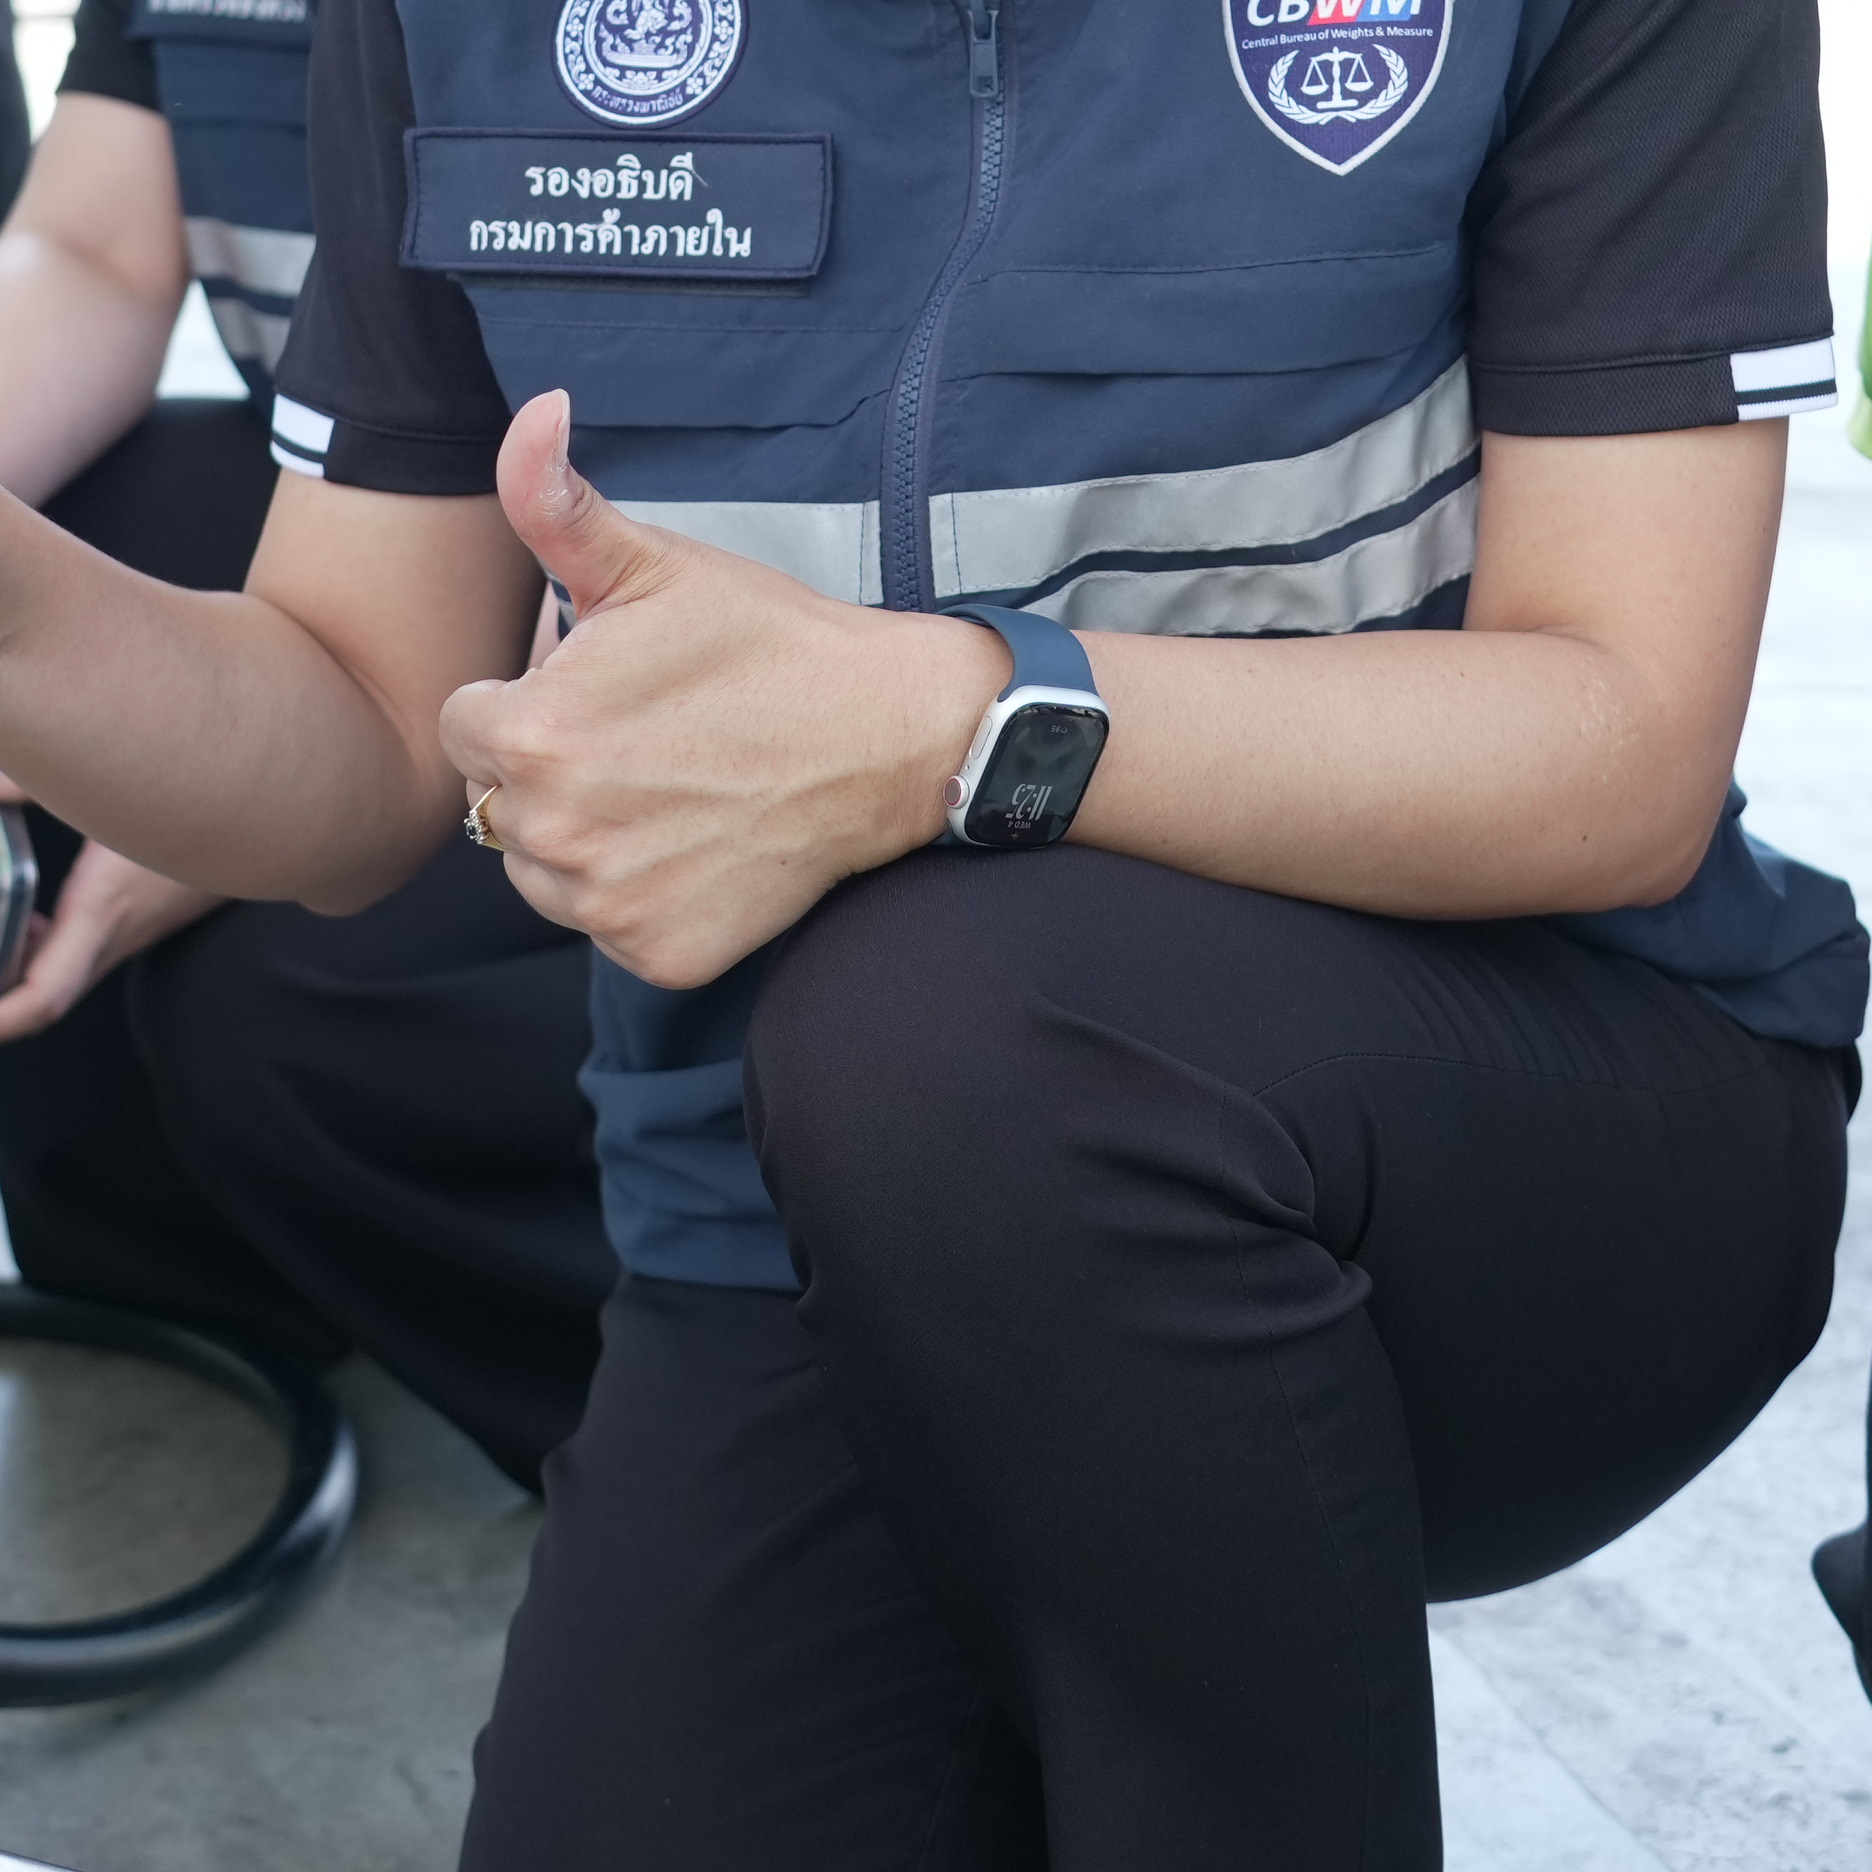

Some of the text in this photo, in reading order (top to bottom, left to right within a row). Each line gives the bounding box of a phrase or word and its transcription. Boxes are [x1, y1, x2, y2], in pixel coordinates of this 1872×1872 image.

[1241, 25, 1434, 50] Central Bureau of Weights & Measure
[525, 152, 694, 202] รองอธิบดี
[469, 208, 752, 259] กรมการค้าภายใน
[1005, 783, 1054, 821] 11:25
[1014, 821, 1031, 829] WED
